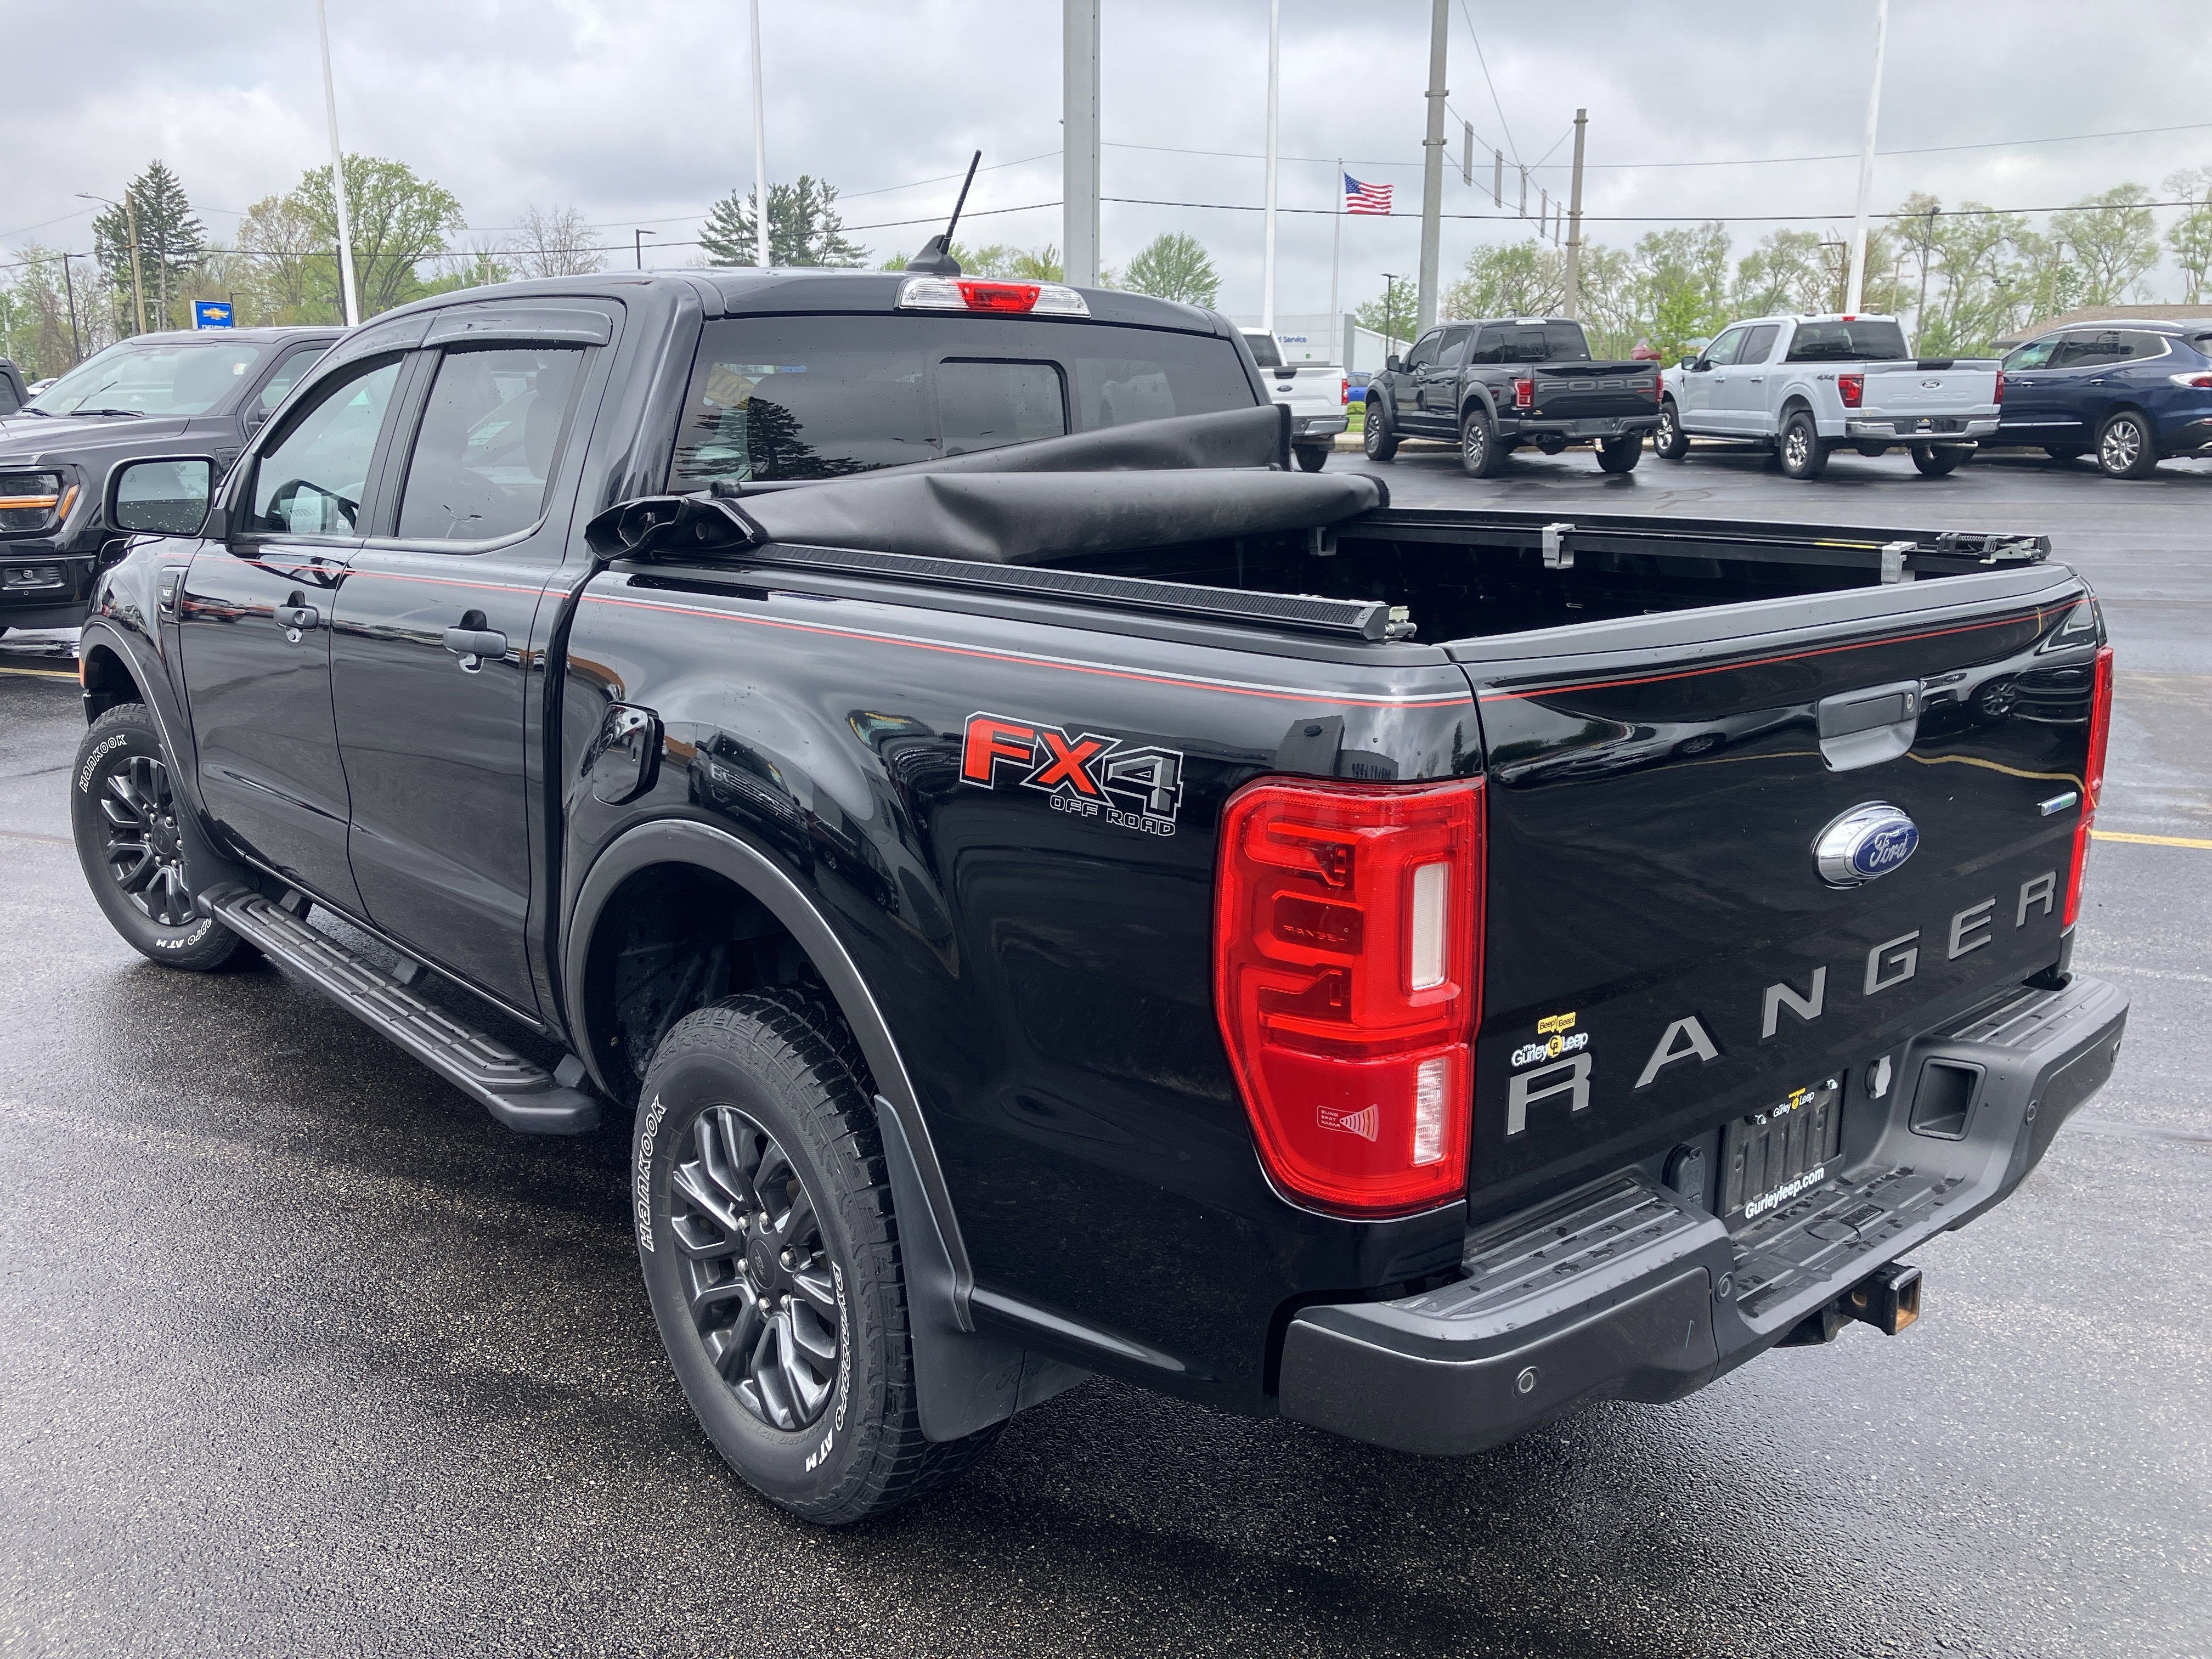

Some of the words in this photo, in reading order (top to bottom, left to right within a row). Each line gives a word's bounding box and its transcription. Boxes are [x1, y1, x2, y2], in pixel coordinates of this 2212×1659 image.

[1538, 379, 1655, 393] FORD
[959, 710, 1184, 822] FX4
[1050, 794, 1098, 817] OFF
[1106, 808, 1175, 837] ROAD
[1869, 829, 1909, 867] Ford
[1506, 871, 2057, 1136] RANGER
[1539, 1018, 1557, 1030] Beep!
[1559, 1015, 1575, 1027] Beep!
[1511, 1043, 1548, 1068] Gurley
[1561, 1032, 1588, 1052] Leep
[1799, 1091, 1815, 1106] Leep
[1745, 1167, 1825, 1219] Gurleyleep.com
